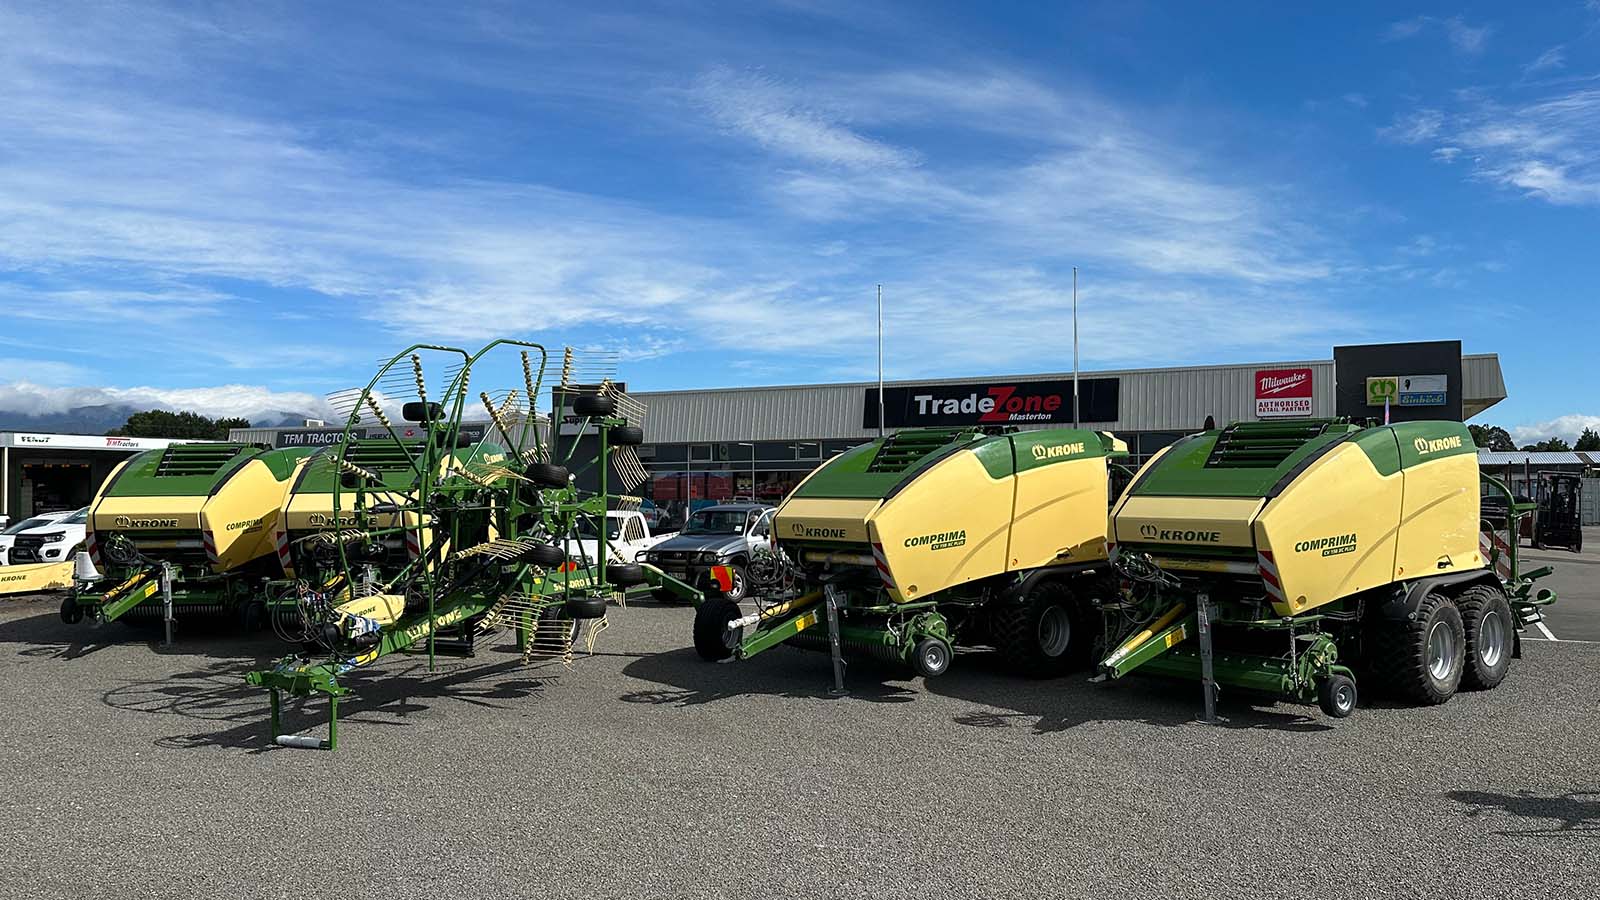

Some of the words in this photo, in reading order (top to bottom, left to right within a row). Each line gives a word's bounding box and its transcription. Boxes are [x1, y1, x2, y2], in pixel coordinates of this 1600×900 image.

[1259, 373, 1307, 391] Milwaukee
[1258, 400, 1310, 408] AUTHORISED
[1008, 413, 1052, 421] Masterton
[283, 433, 304, 445] TFM
[1429, 435, 1462, 452] KRONE
[1047, 442, 1085, 458] KRONE
[130, 519, 179, 528] KRONE
[226, 518, 263, 531] COMPRIMA
[326, 517, 378, 526] KROE
[805, 527, 847, 538] KRONE
[904, 530, 966, 547] COMPRIMA
[1160, 530, 1221, 542] KRONE
[1294, 533, 1357, 553] COMPRIMA
[553, 579, 585, 591] SWDRO
[422, 608, 462, 634] KONE
